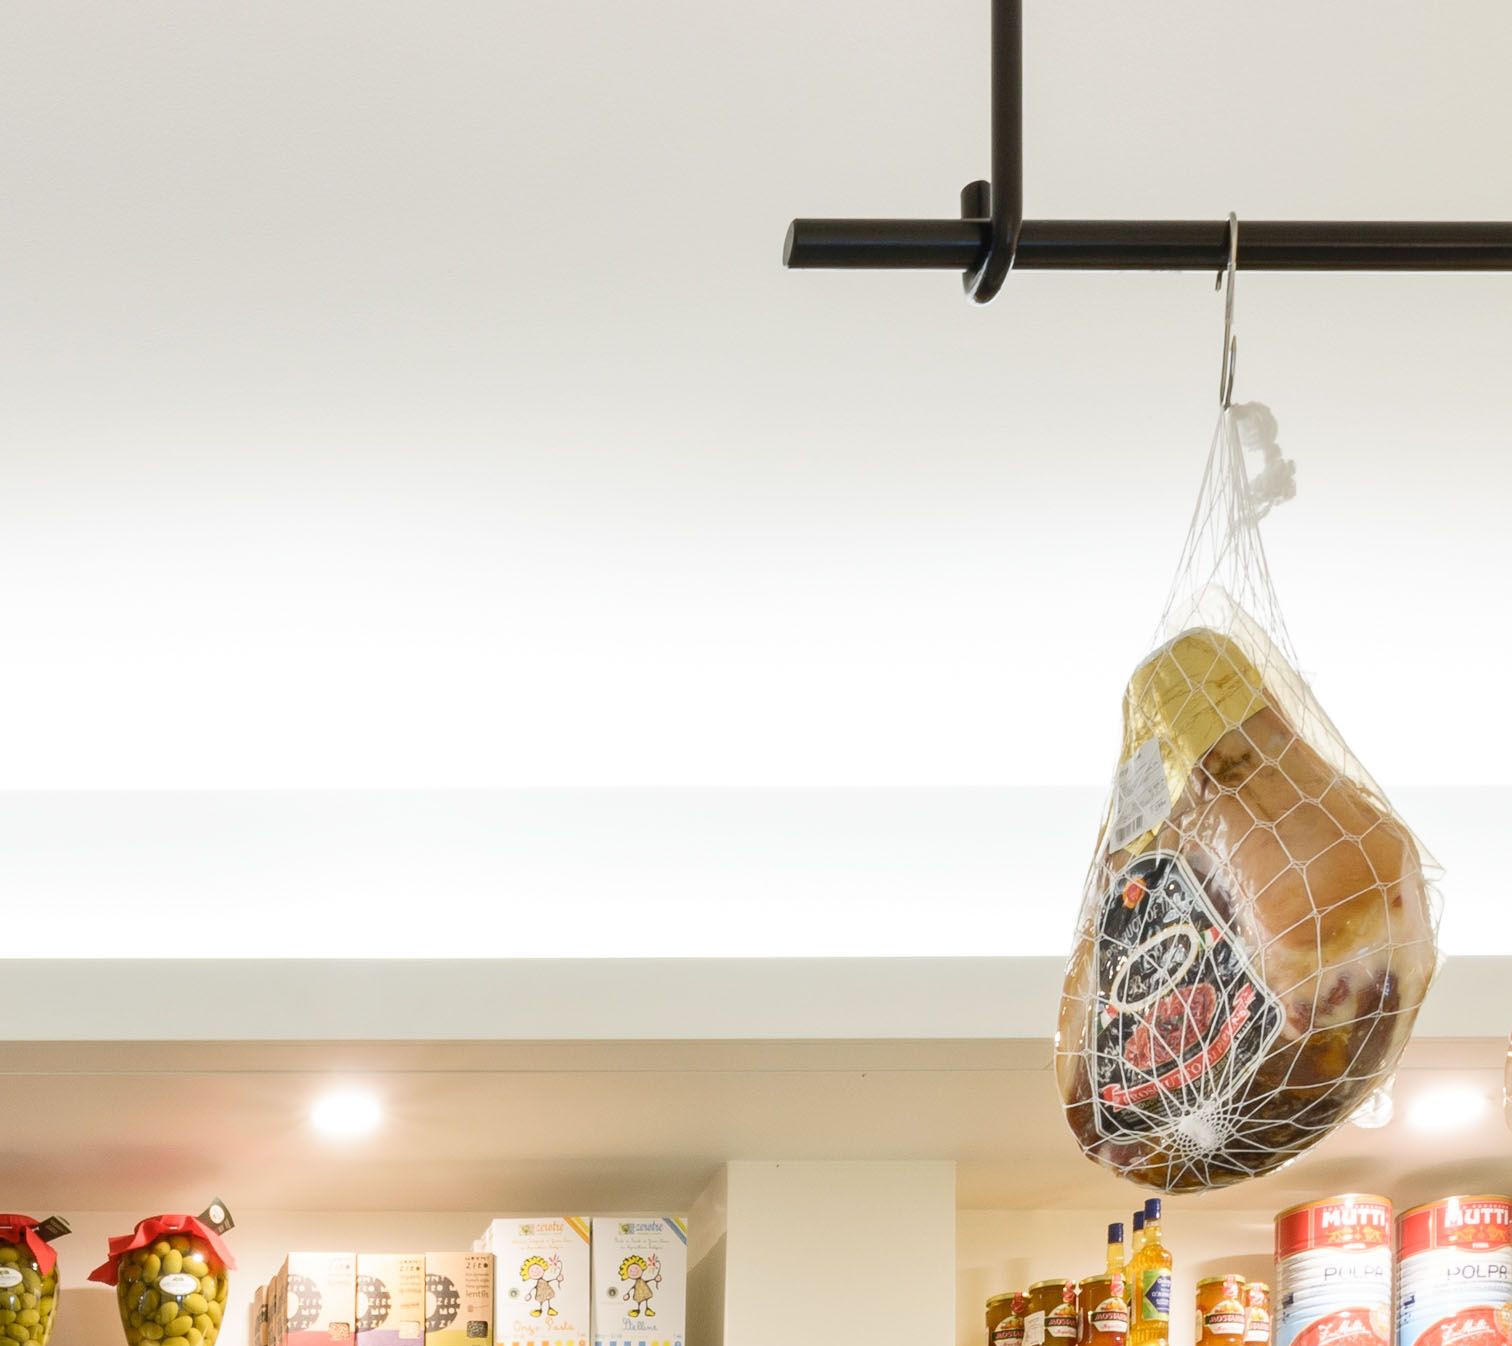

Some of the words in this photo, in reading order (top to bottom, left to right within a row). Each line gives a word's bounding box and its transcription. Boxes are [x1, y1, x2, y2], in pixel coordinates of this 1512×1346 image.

[1322, 1208, 1386, 1228] MUTTI
[1444, 1206, 1510, 1227] MUTTI
[465, 1289, 489, 1298] lentils
